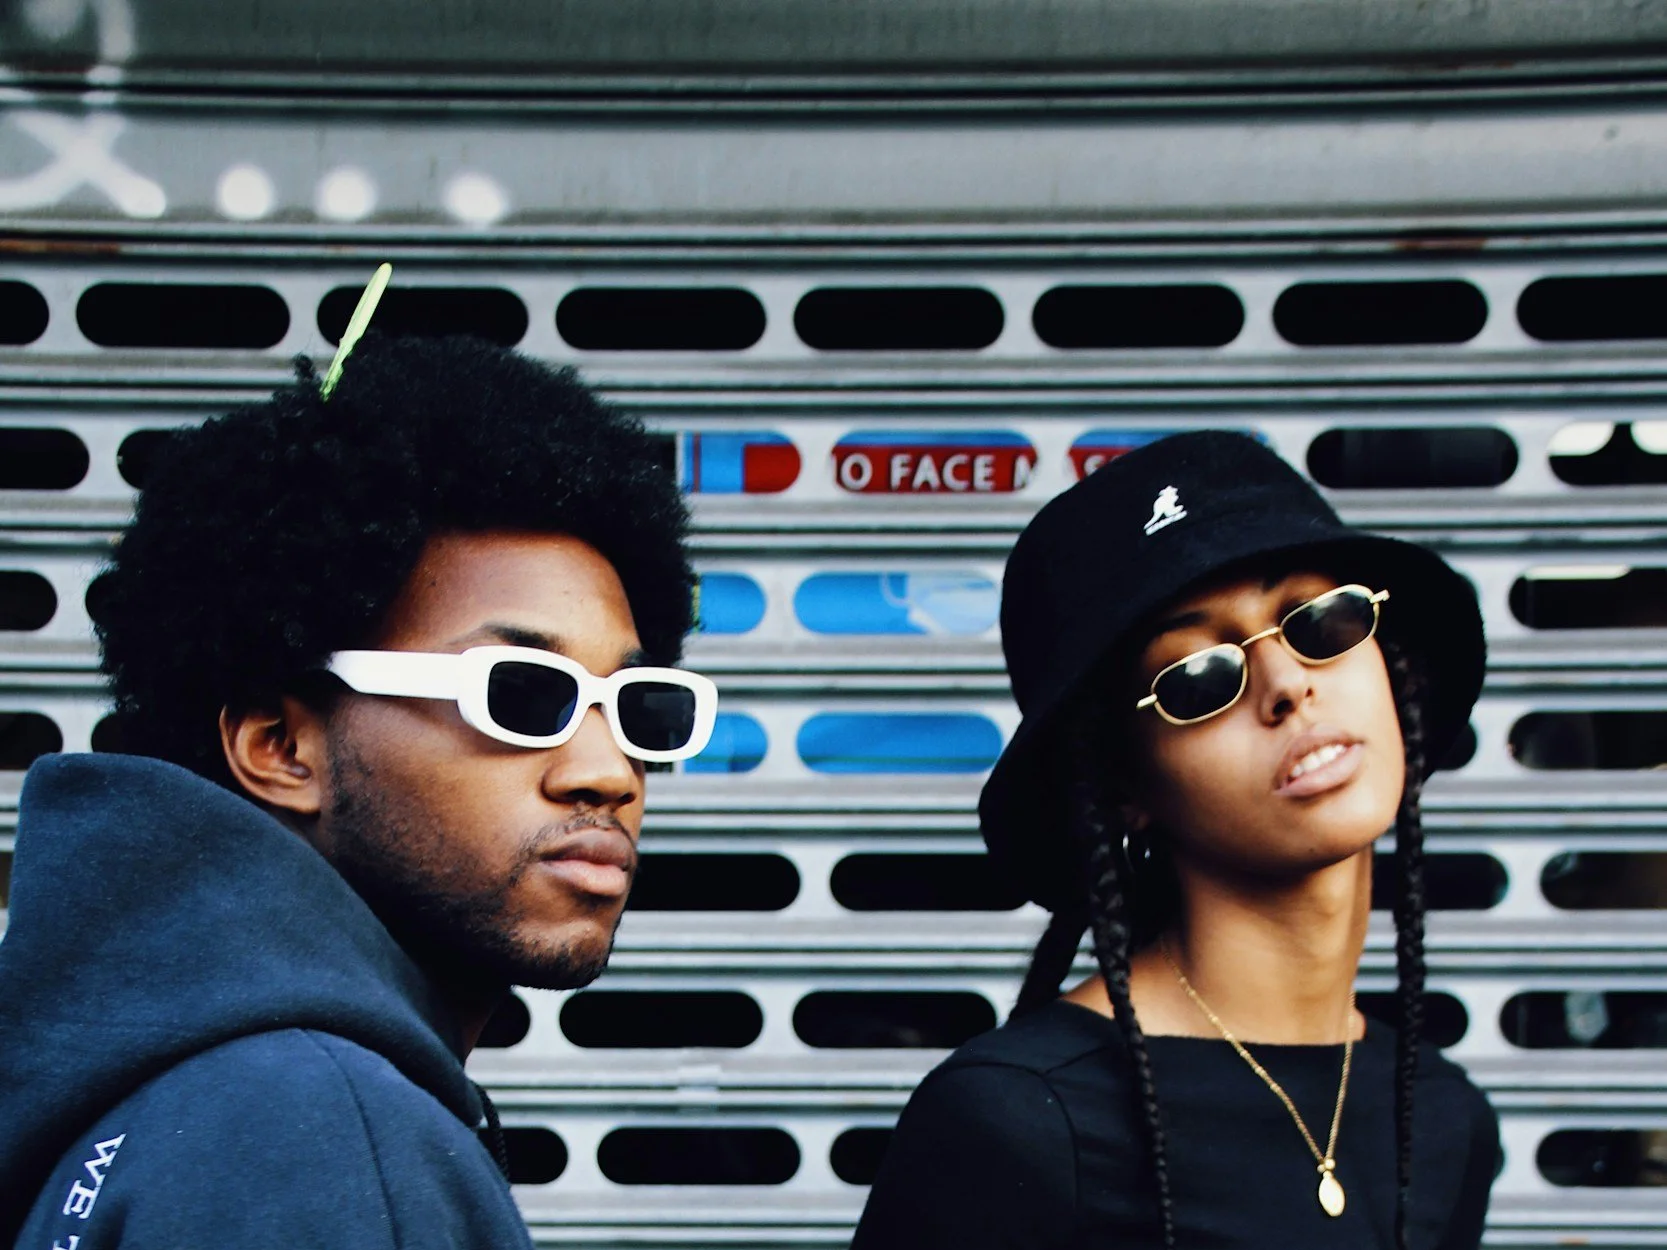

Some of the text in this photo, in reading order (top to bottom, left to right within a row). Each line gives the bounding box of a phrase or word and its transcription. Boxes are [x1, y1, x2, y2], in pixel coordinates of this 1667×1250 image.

[832, 453, 873, 490] O
[890, 453, 995, 490] FACE
[62, 1133, 126, 1220] WE
